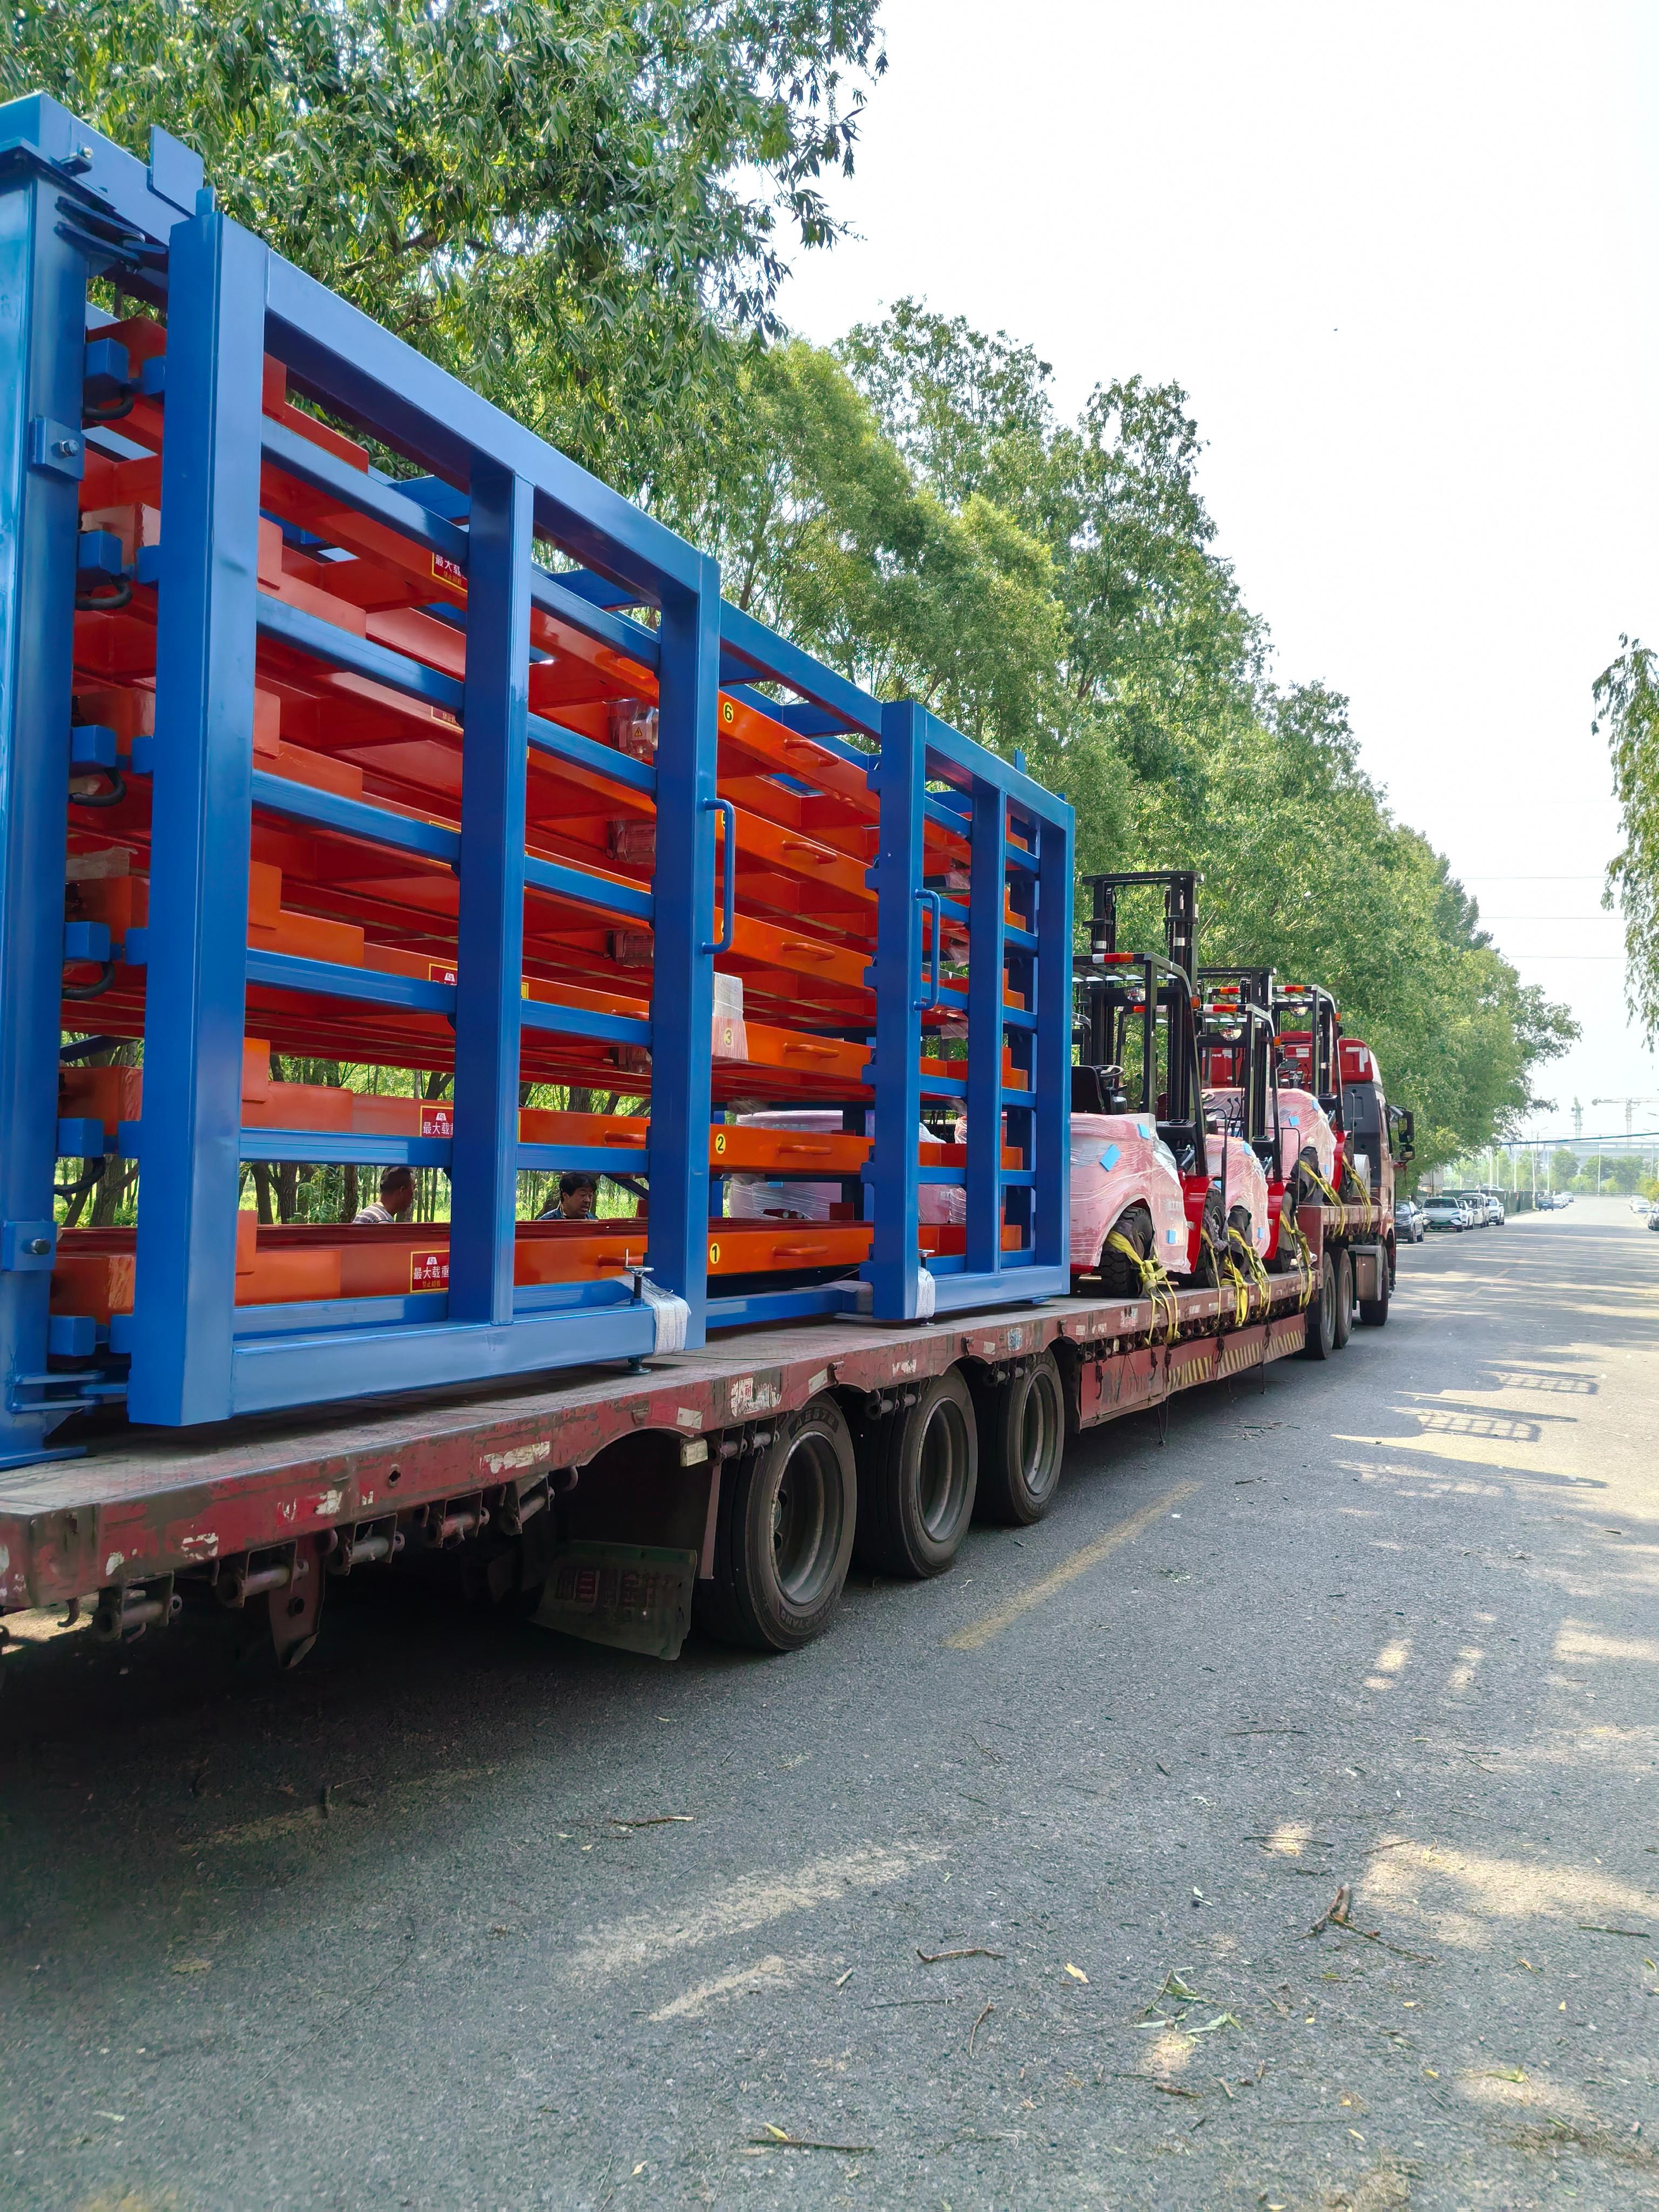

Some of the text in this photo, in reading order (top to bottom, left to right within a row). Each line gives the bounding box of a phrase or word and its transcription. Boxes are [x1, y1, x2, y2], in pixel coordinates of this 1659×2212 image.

[725, 704, 732, 720] 6
[726, 1029, 732, 1045] 3
[718, 1136, 724, 1151] 2
[712, 1245, 717, 1262] 1
[414, 1265, 449, 1280] 最大载重
